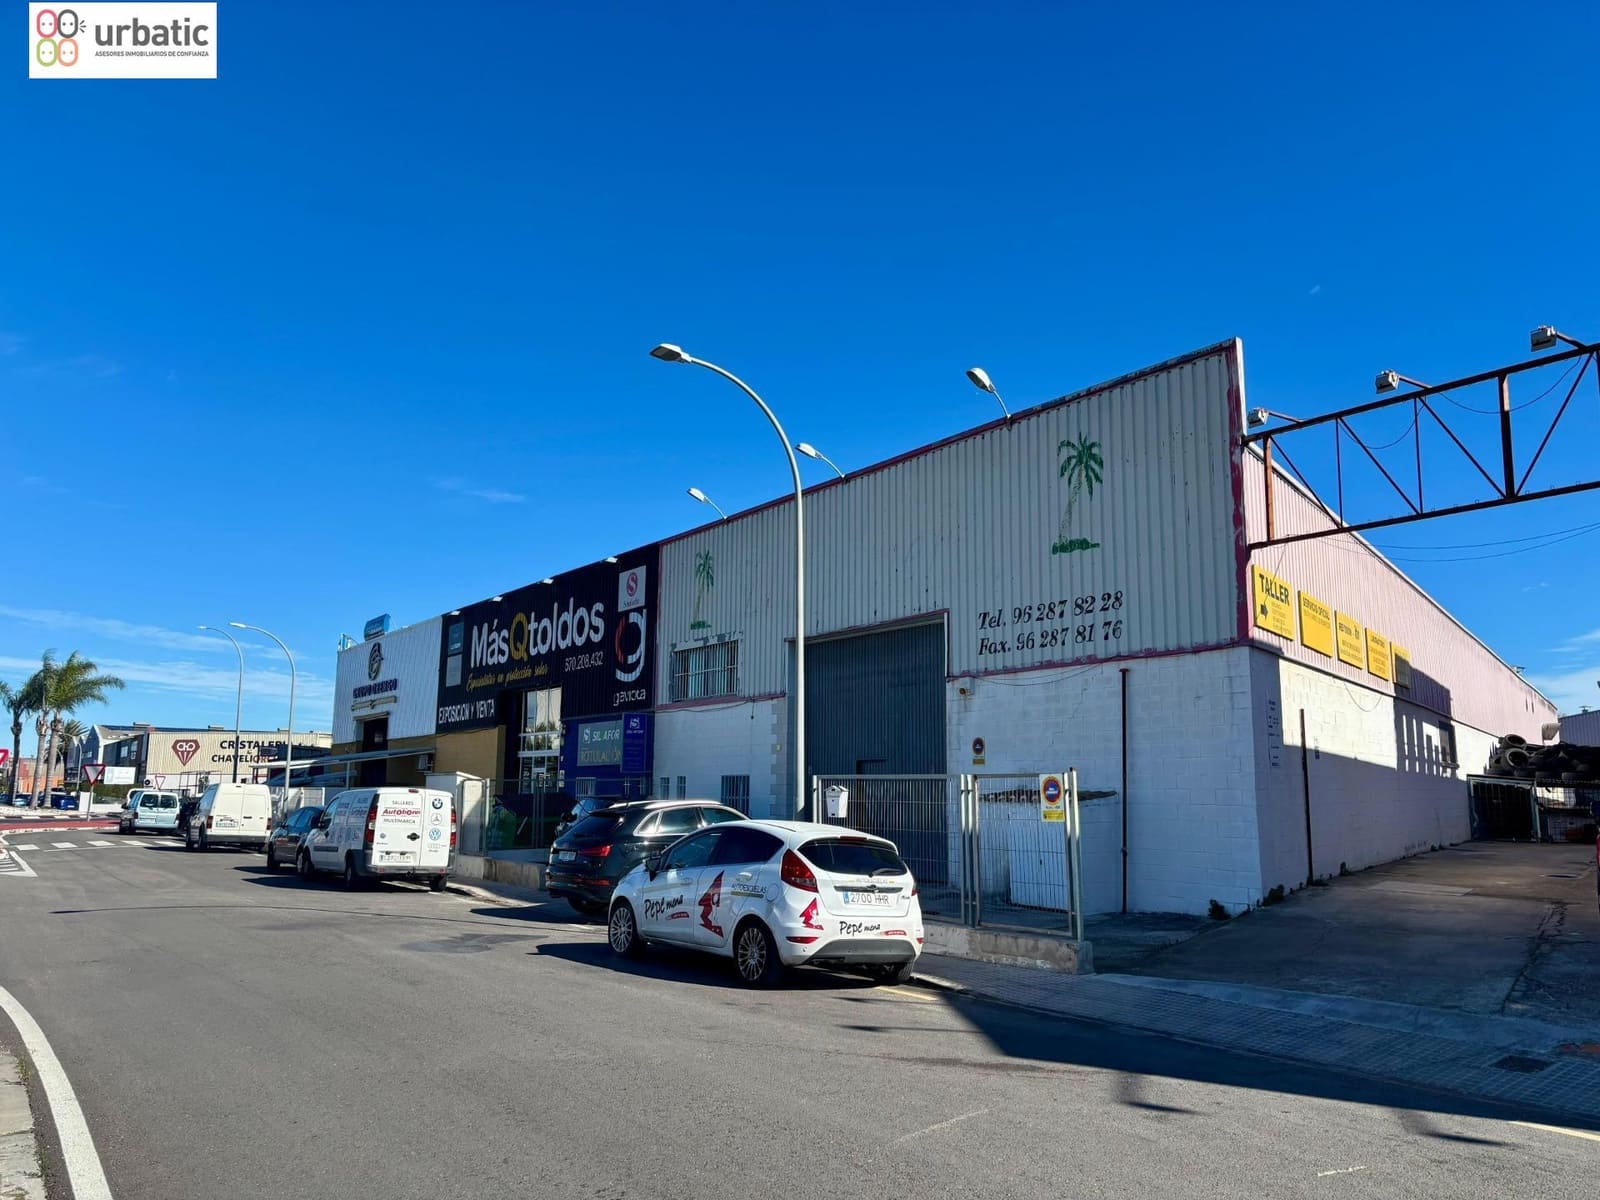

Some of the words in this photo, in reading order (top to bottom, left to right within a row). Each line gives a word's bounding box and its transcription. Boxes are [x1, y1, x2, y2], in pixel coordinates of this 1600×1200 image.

[1259, 573, 1290, 606] TALLER
[978, 608, 1007, 631] Tel.
[1013, 605, 1032, 624] 96
[1035, 600, 1068, 622] 287
[1074, 595, 1096, 616] 82
[1099, 590, 1124, 612] 28
[470, 597, 605, 668] MásQtoldos
[978, 636, 1011, 656] Fax.
[1016, 632, 1035, 651] 96
[1039, 627, 1070, 648] 287
[1075, 624, 1096, 644] 81
[1102, 620, 1123, 640] 76
[476, 698, 495, 718] VENTA
[613, 688, 646, 706] gaviota
[604, 728, 620, 740] AFOR
[644, 896, 665, 922] Pepe
[851, 893, 872, 903] 2700
[874, 895, 890, 904] HHR
[840, 921, 862, 936] Pepe
